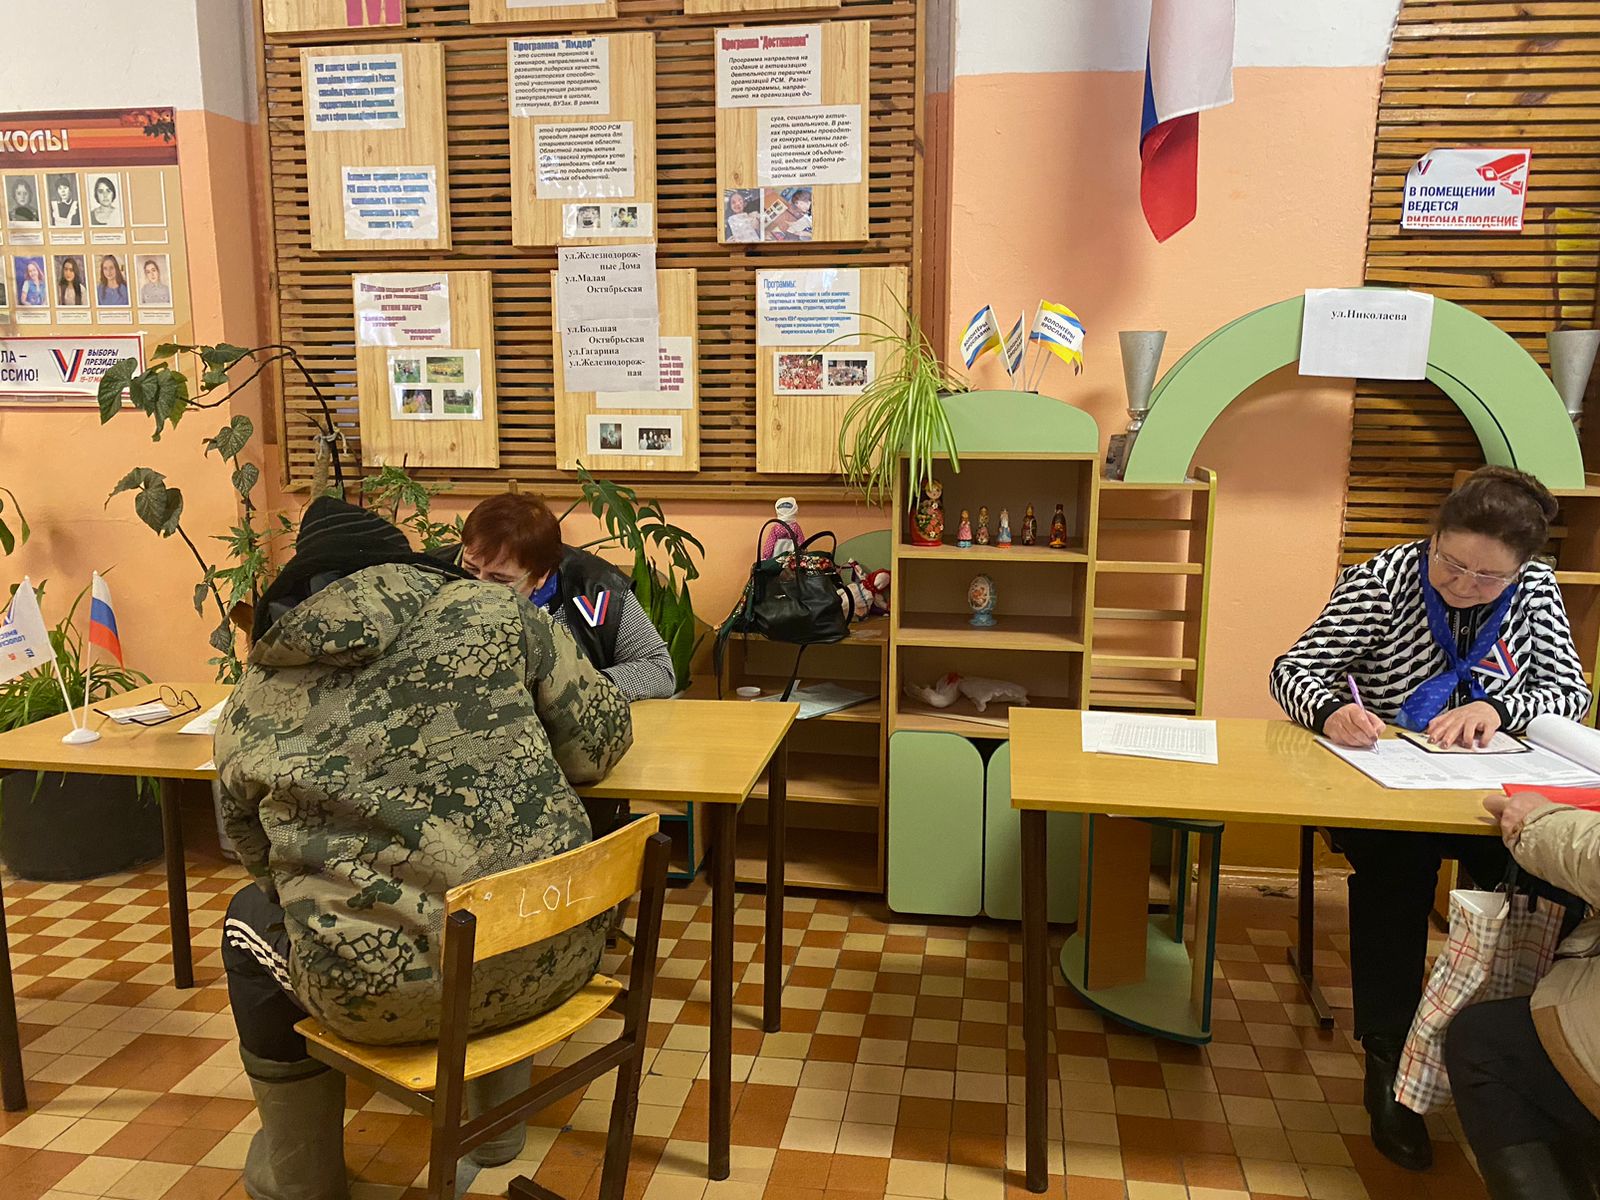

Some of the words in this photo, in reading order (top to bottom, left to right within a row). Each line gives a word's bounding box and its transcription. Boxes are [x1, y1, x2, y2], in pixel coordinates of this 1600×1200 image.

[514, 41, 559, 52] Программа
[562, 39, 595, 48] "Лидер"
[1409, 186, 1416, 196] В
[1420, 186, 1496, 198] ПОМЕЩЕНИИ
[1408, 200, 1458, 213] ВЕДЕТСЯ
[564, 251, 641, 261] ул.Железнодорож-
[619, 262, 641, 271] Дома
[565, 274, 606, 284] ул.Малая
[587, 285, 642, 294] Октябрьская
[1331, 309, 1407, 321] ул.Николаева
[567, 325, 617, 335] ул.Большая
[1044, 316, 1076, 340] ВОЛОНТЁРЫ
[1041, 322, 1073, 345] ЯРОСЛАВИИ
[589, 336, 645, 345] Октябрьская
[568, 348, 619, 357] ул.Гагарина
[84, 358, 125, 366] ПРЕЗИДЕ
[569, 358, 645, 368] ул.Железнодорож-
[1, 369, 38, 381] ССИЮ!
[519, 876, 596, 918] LOL
